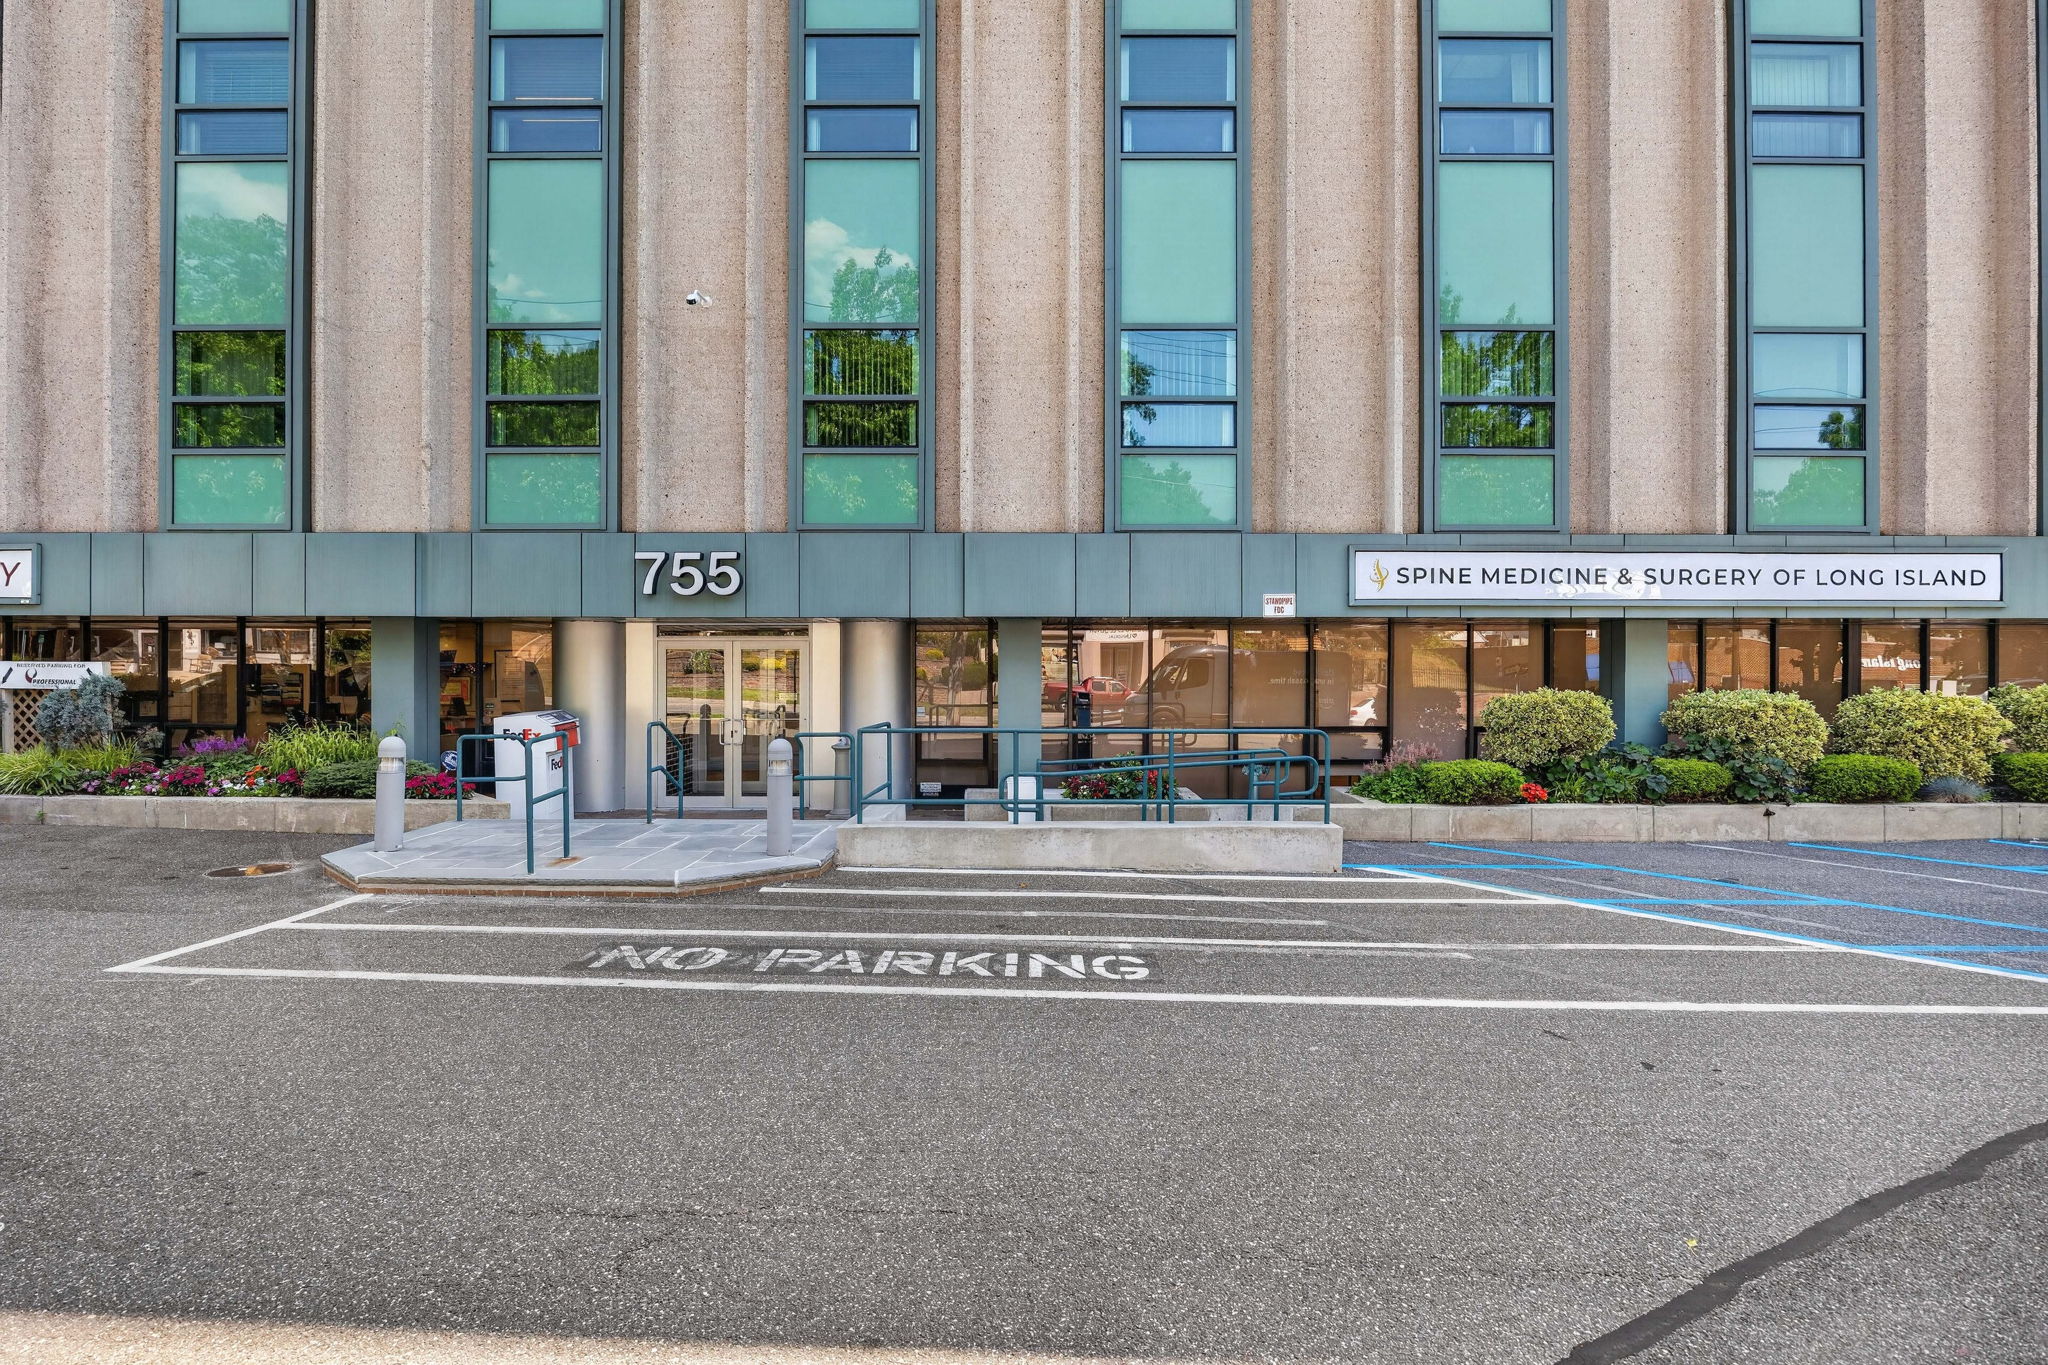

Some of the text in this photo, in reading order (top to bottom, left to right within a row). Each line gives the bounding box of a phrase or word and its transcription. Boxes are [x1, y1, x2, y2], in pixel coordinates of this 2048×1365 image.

[0, 561, 21, 587] Y
[634, 551, 742, 596] 755
[1396, 567, 1986, 586] SPINE MEDICINE & SURGERY OF LONG ISLAND
[588, 945, 1150, 980] NO PARKING
